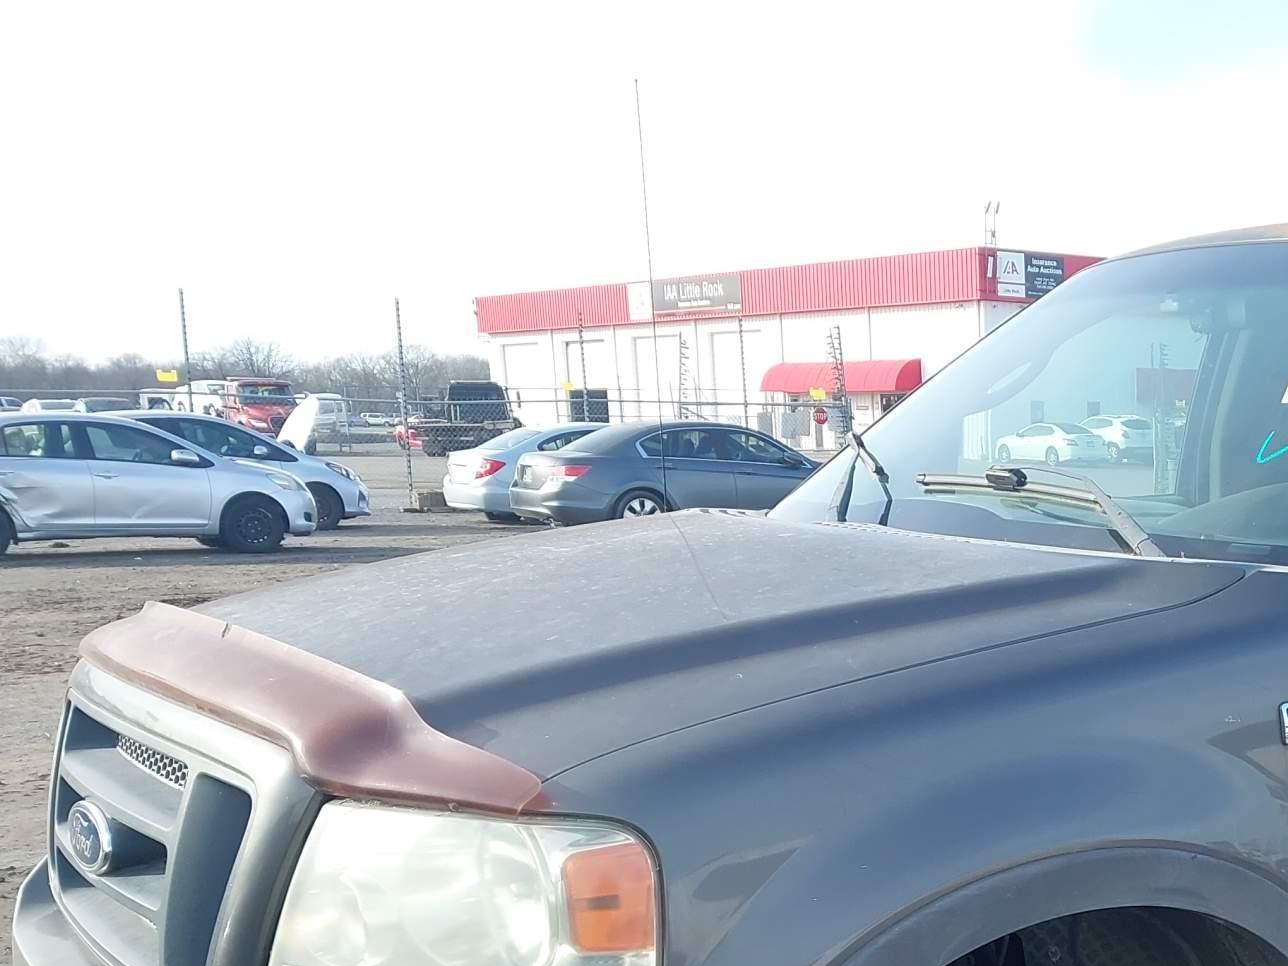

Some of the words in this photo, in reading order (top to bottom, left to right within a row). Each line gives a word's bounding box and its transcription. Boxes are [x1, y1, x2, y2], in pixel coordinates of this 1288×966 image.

[1040, 266, 1063, 275] Auctions
[663, 284, 678, 300] IAA
[679, 282, 700, 298] Little
[702, 280, 724, 297] Rock
[71, 812, 94, 858] Ford
